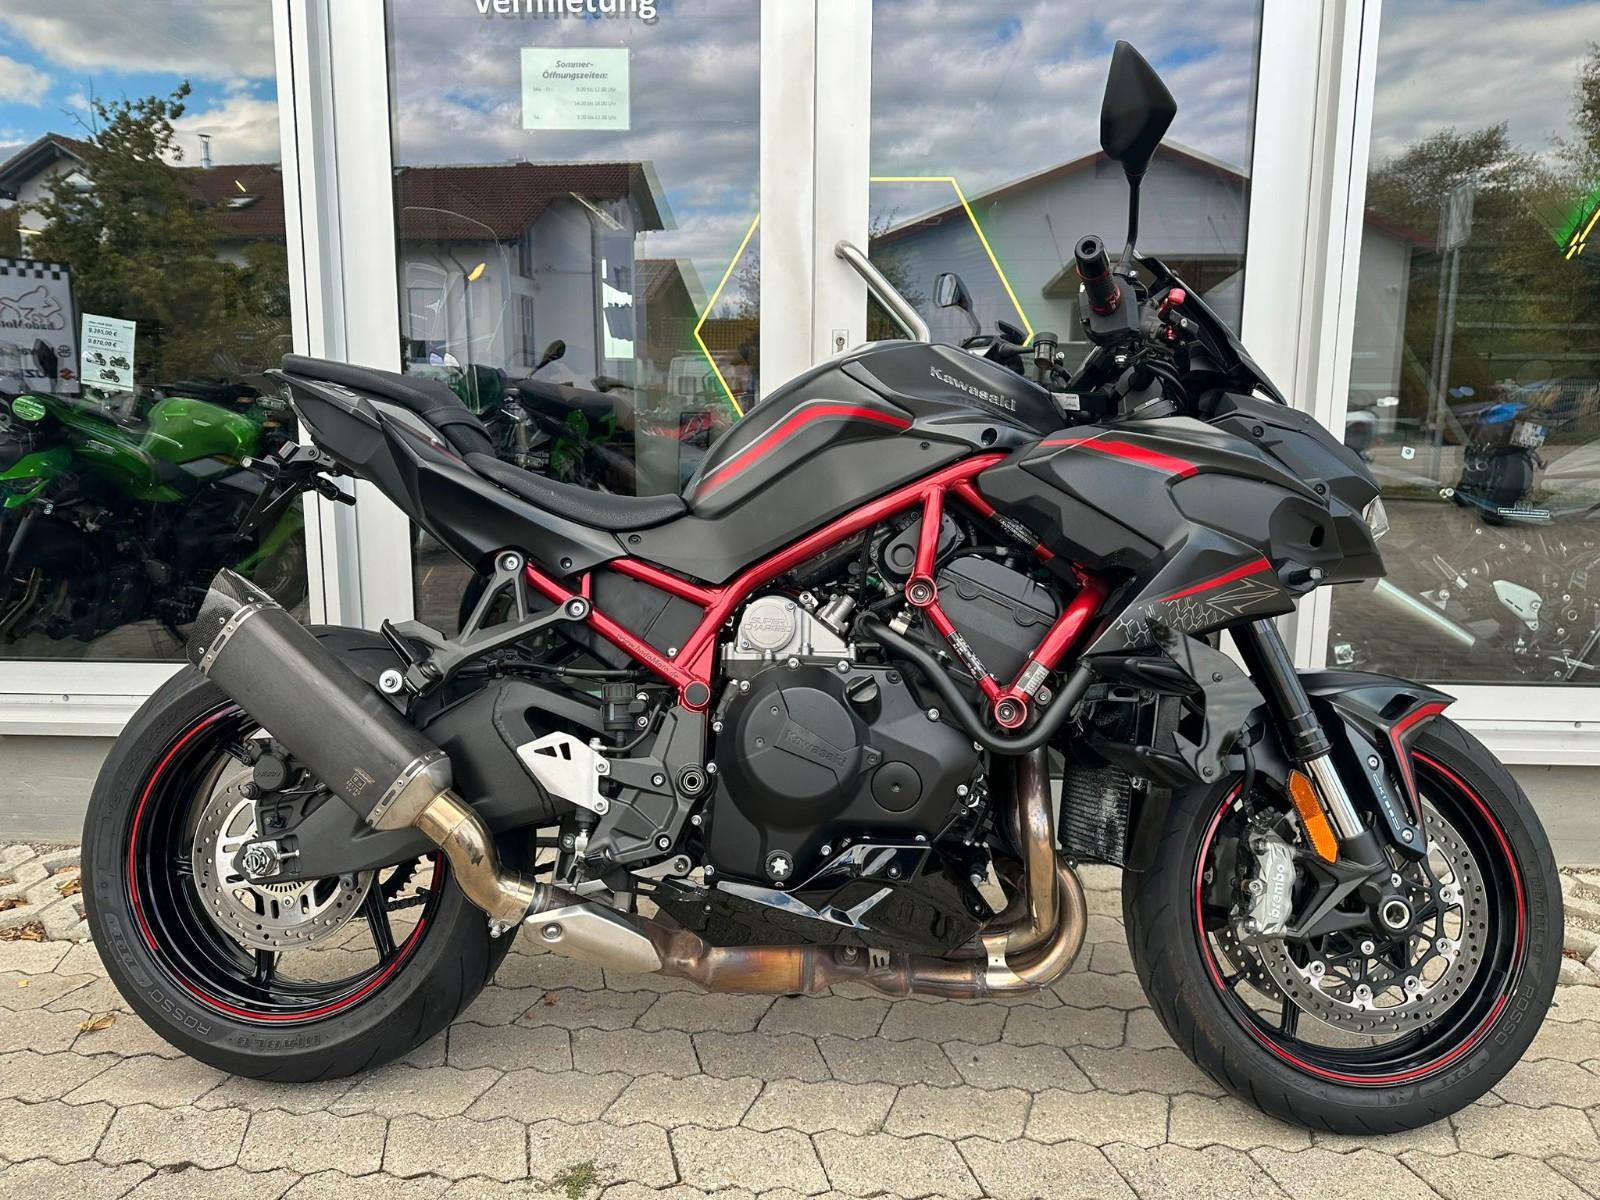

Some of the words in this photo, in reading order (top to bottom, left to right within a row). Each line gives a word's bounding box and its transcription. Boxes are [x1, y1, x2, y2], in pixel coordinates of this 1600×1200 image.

[542, 69, 608, 80] Öffnungszeiten:
[555, 60, 594, 68] Sommer-
[930, 366, 1017, 412] Kawasaki
[784, 729, 848, 767] Kawasaki
[1268, 864, 1285, 920] brembo
[150, 988, 212, 1036] ROSSO
[1494, 985, 1535, 1045] ROSSO
